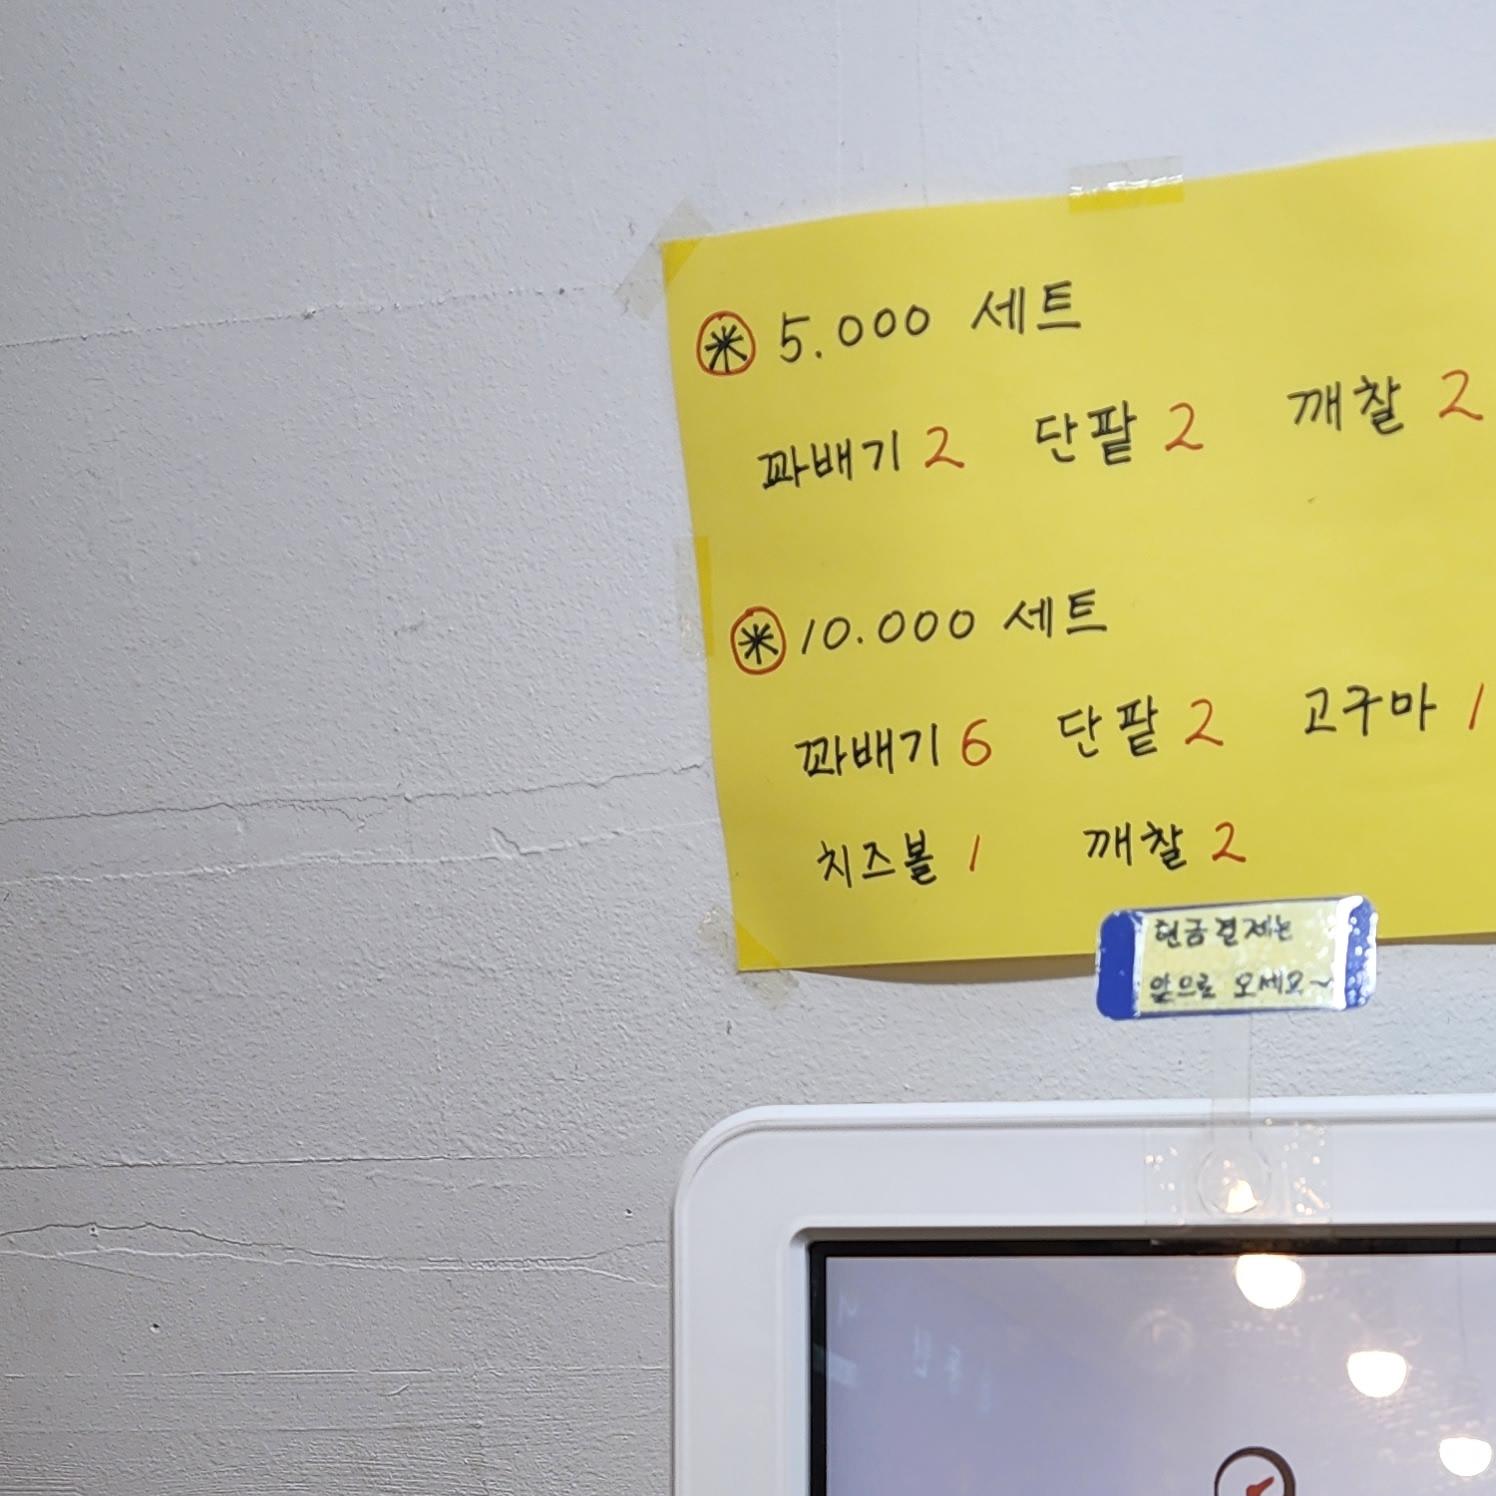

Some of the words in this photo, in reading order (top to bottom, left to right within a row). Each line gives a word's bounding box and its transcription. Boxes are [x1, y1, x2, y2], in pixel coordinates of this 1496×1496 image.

[776, 301, 932, 366] 5.000
[968, 276, 1085, 337] 세트
[921, 422, 967, 470] 2
[1032, 398, 1139, 467] 단팥
[1162, 400, 1207, 453] 2
[1284, 370, 1404, 437] 깨찰
[1434, 366, 1485, 421] 2
[798, 603, 976, 658] 10.000
[1000, 585, 1111, 638] 세트
[793, 720, 942, 778] 꽈배기
[958, 715, 994, 767] 6
[1055, 692, 1162, 760] 단팥
[1182, 697, 1227, 749] 2
[1301, 679, 1439, 739] 고구마
[1464, 681, 1486, 734] 1
[815, 827, 936, 892] 치즈볼
[963, 833, 983, 874] 1
[1080, 819, 1186, 871] 깨찰
[1210, 819, 1249, 866] 2
